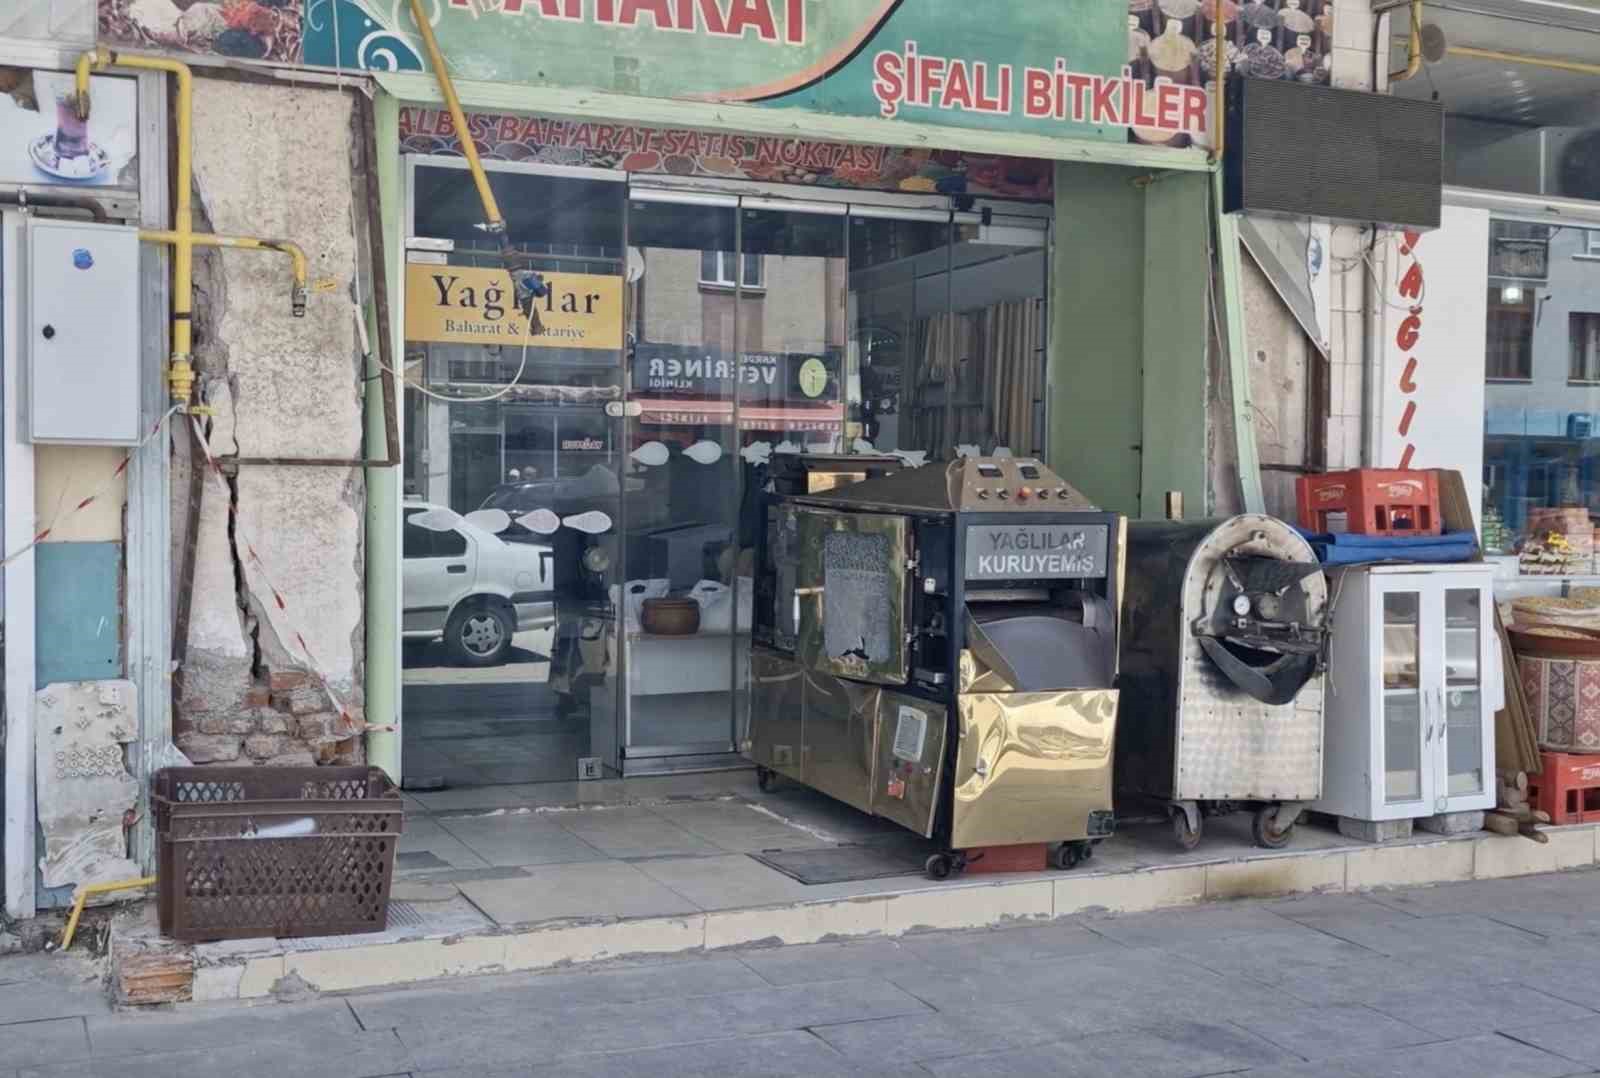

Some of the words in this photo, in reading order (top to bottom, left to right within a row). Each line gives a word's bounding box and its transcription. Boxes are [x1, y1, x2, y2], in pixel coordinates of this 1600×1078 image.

[448, 0, 805, 44] ARAT
[873, 41, 1013, 118] ŞİFALI
[1024, 58, 1208, 133] BİTKİLER
[398, 106, 488, 140] ALBS
[496, 112, 657, 155] BAHARAT
[663, 127, 746, 167] SATIŞ
[754, 135, 889, 171] NOKTASI
[431, 275, 602, 321] Yağllar
[444, 319, 501, 335] Baharat
[508, 321, 519, 335] &
[989, 528, 1086, 551] YAĞLILAR
